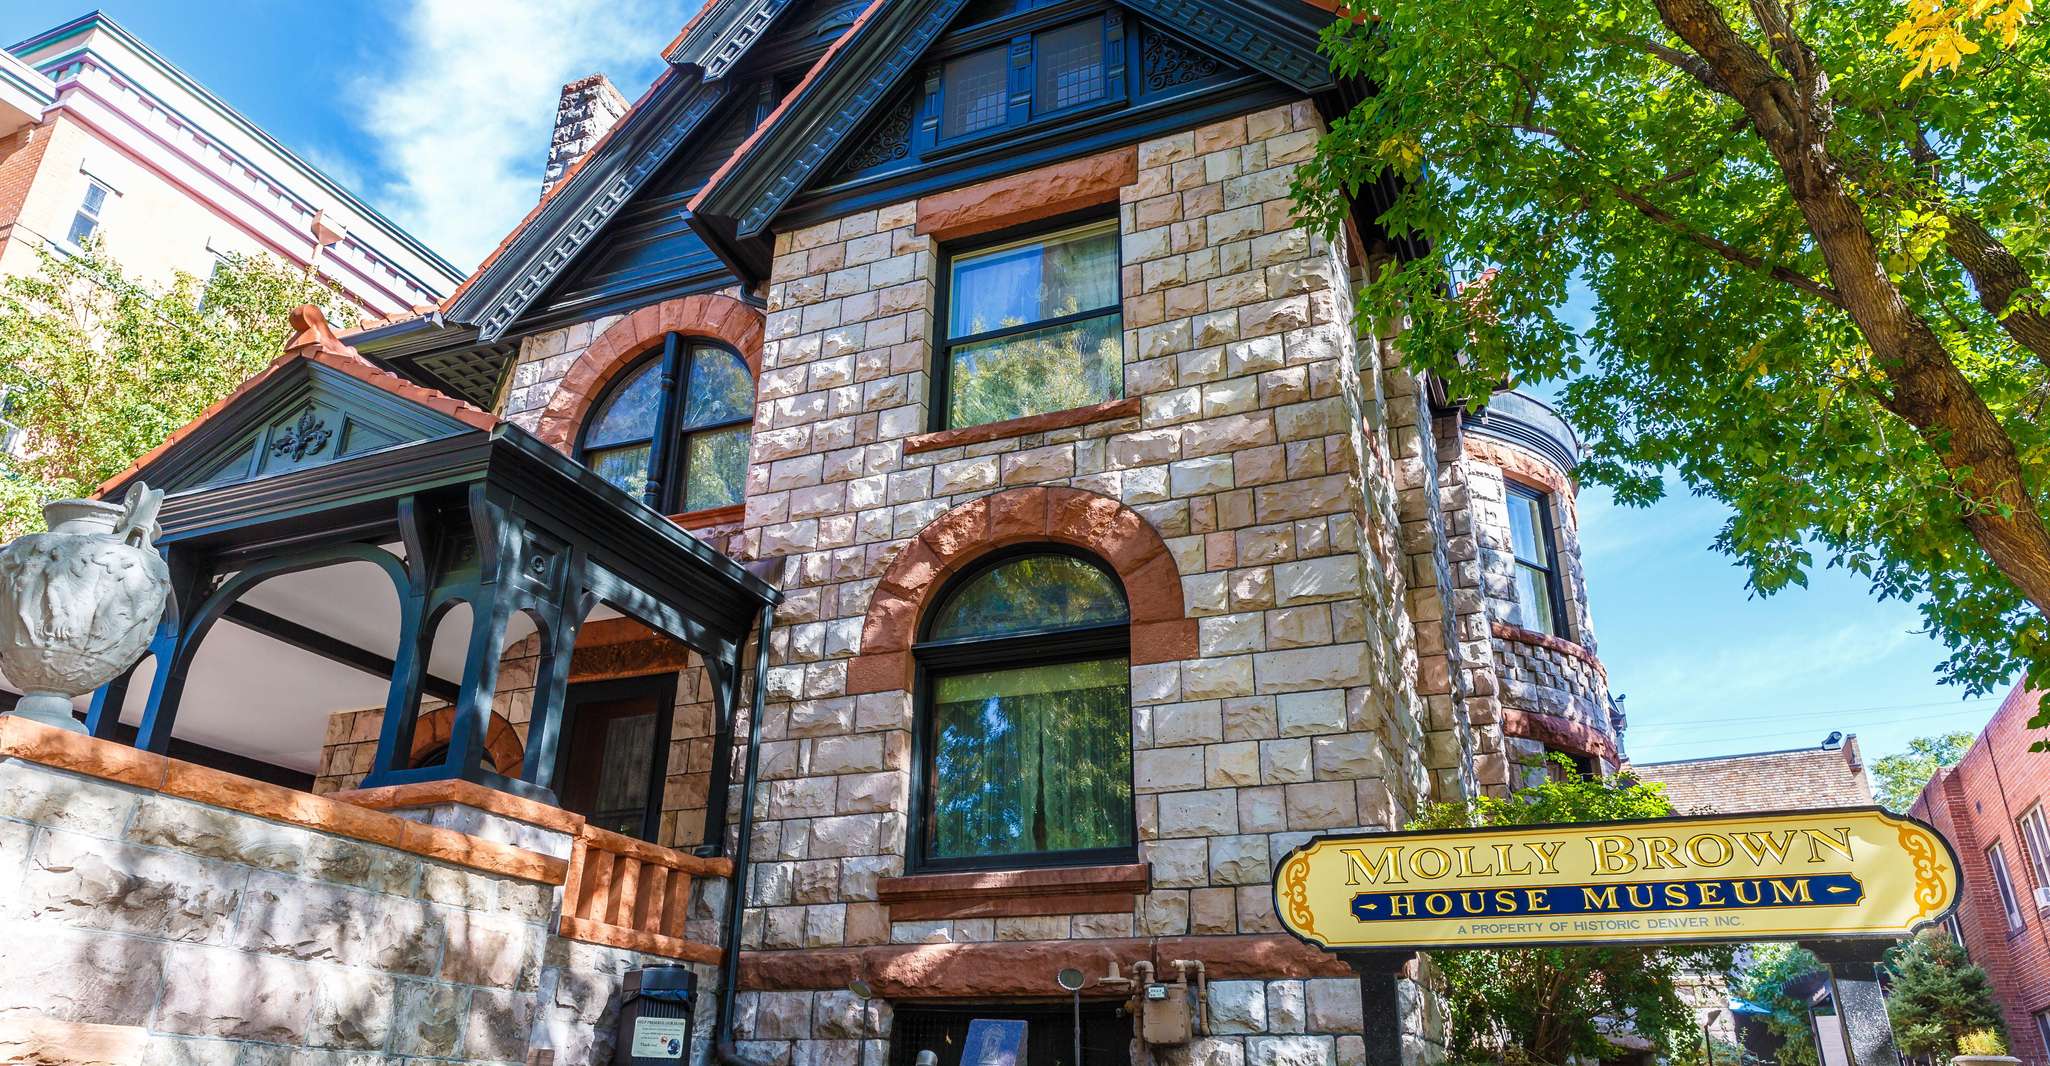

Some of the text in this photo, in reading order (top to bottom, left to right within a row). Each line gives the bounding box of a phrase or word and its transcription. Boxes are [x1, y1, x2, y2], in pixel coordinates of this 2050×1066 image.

[1340, 828, 1854, 885] MOLLY BROWN
[1390, 879, 1812, 916] HOUSE MUSEUM
[1457, 916, 1744, 935] A PROPERTY OF HISTORIC DENVER INC.
